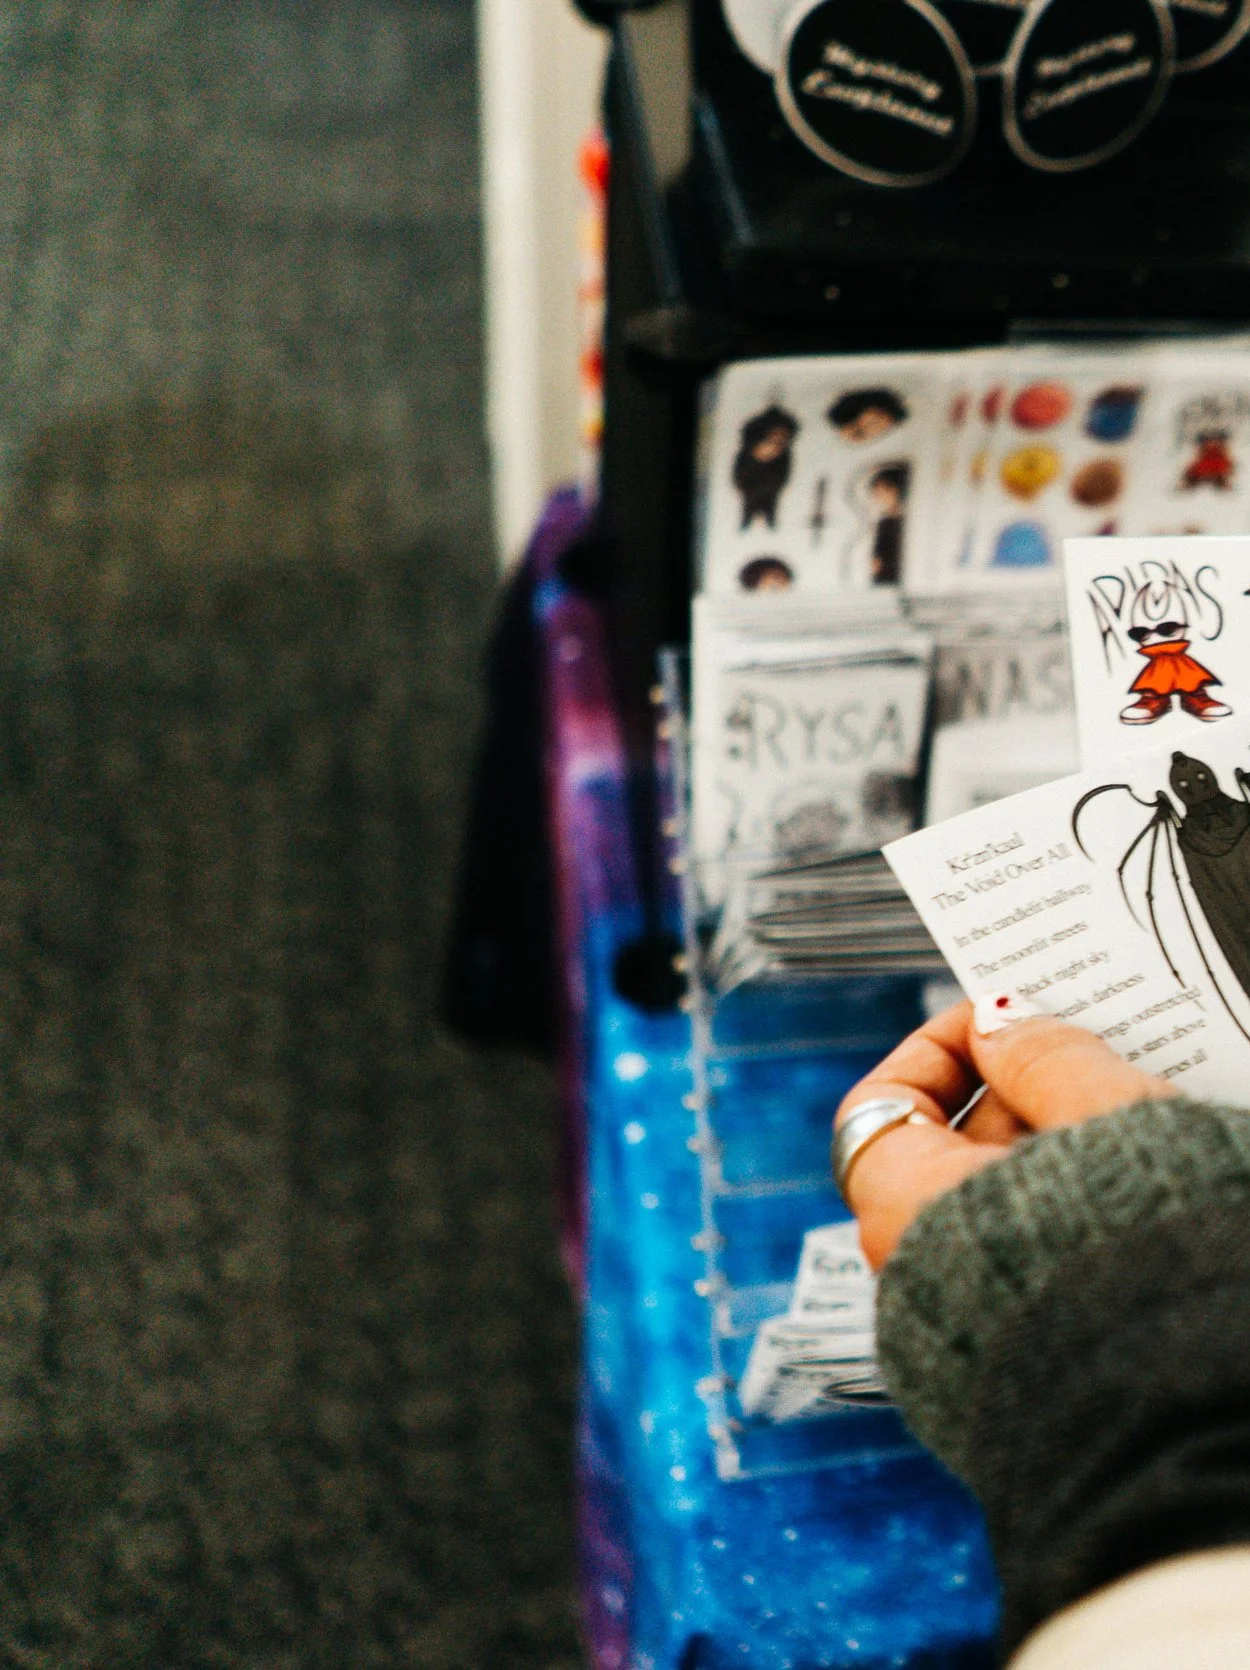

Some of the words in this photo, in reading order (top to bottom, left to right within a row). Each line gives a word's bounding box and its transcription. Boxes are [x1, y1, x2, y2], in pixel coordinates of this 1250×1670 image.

[931, 889, 968, 910] The
[965, 869, 1008, 894] Void
[1004, 856, 1045, 880] Over
[1048, 842, 1074, 864] All
[953, 934, 971, 948] In
[970, 926, 991, 941] the
[1041, 882, 1093, 909] hallway
[970, 962, 999, 979] The
[999, 937, 1050, 967] moonlit
[1050, 921, 1090, 942] streets
[1015, 975, 1055, 997] black
[1054, 960, 1088, 981] night
[1088, 951, 1112, 967] sky
[1055, 998, 1091, 1019] veals
[1091, 972, 1146, 1003] darkness
[1131, 985, 1202, 1024] outstretched
[1142, 1036, 1170, 1053] stars
[1171, 1018, 1208, 1040] above
[1192, 1048, 1209, 1066] all
